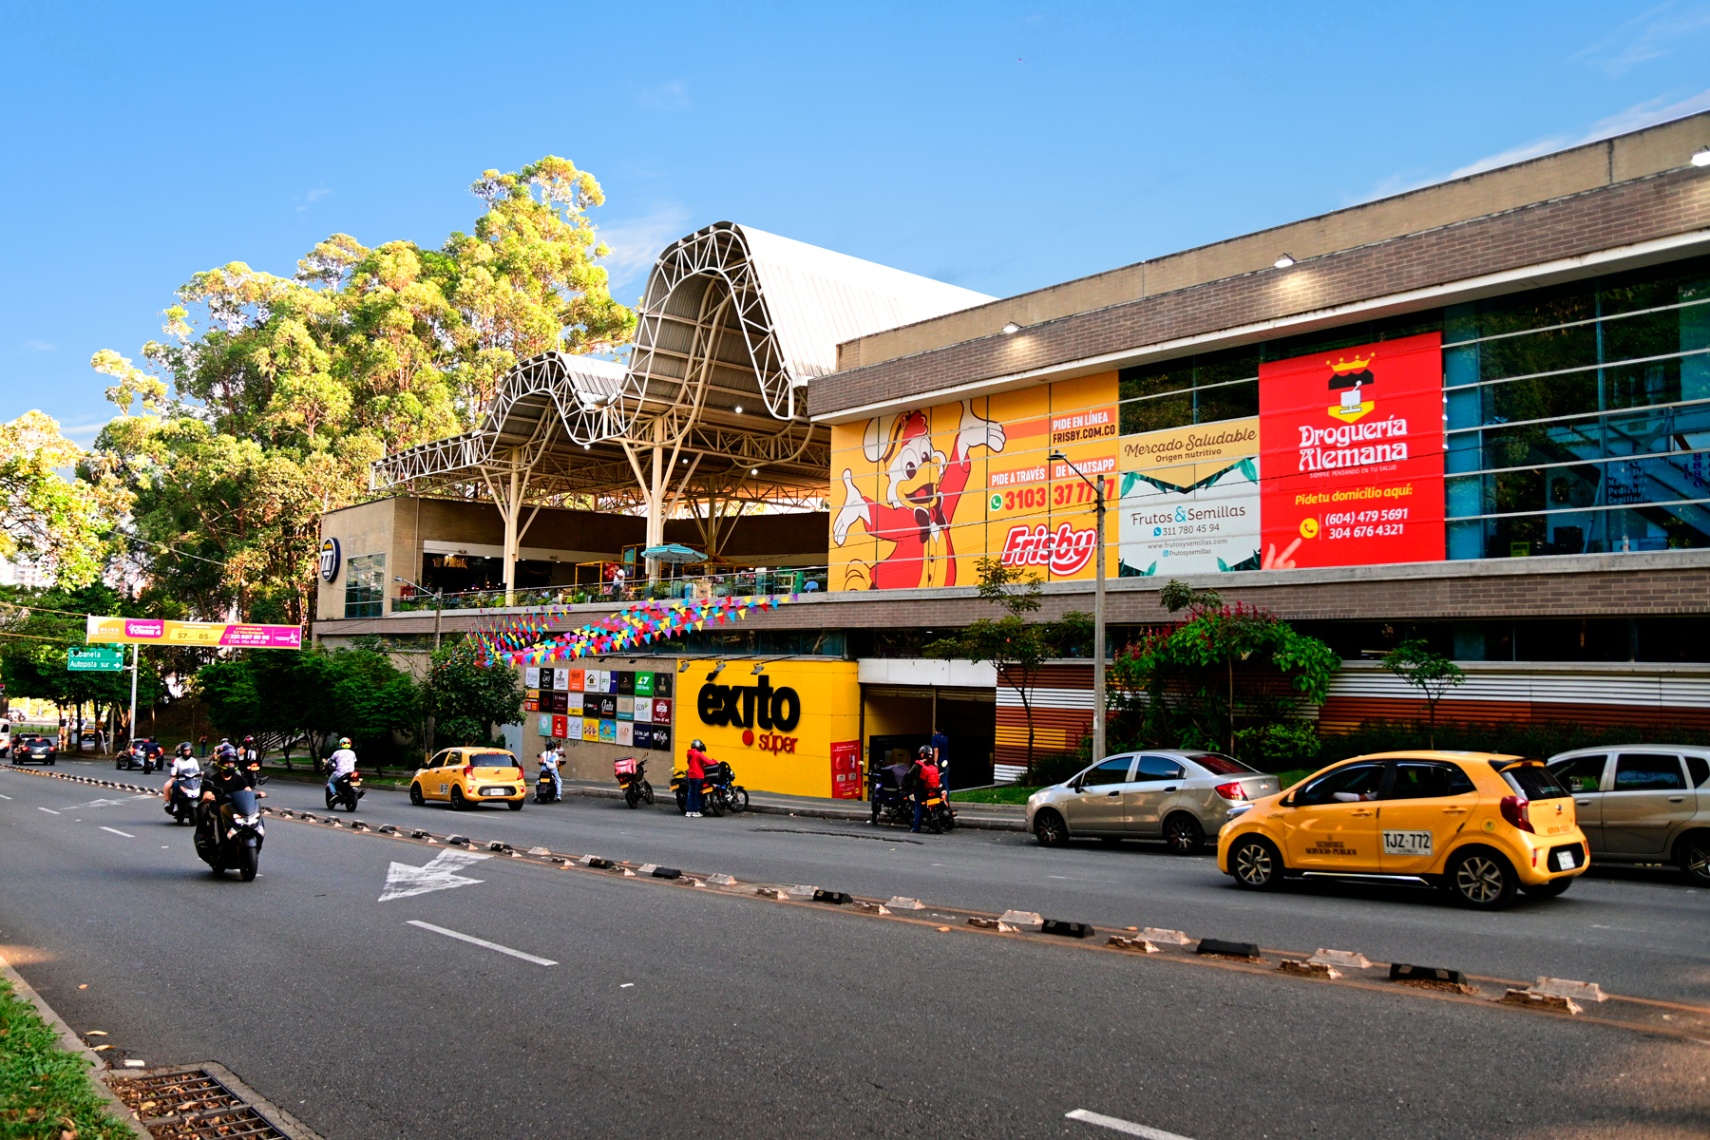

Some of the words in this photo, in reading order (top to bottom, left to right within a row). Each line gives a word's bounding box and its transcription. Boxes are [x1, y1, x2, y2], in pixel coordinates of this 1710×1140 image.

[1052, 418, 1071, 432] PIDE
[1072, 416, 1083, 428] EN
[1084, 410, 1109, 426] LÍNEA
[1298, 414, 1408, 448] Droguería
[1052, 424, 1116, 444] FRISBY.COM.CO
[1125, 437, 1184, 458] Mercado
[1185, 428, 1257, 451] Saludable
[1155, 453, 1183, 463] Origen
[1185, 448, 1222, 459] nutritivo
[1298, 441, 1408, 472] Alemana
[991, 472, 1009, 486] PIDE
[1009, 471, 1016, 484] A
[1016, 465, 1046, 482] TRAVÉS
[1055, 465, 1067, 478] DE
[1331, 468, 1360, 478] PENSANDO
[1379, 464, 1397, 472] SALUD
[1004, 487, 1046, 511] 3103
[1053, 483, 1073, 506] 37
[1332, 486, 1383, 503] domicilio
[1384, 483, 1414, 500] aquí:
[1131, 511, 1173, 526] Frutos
[1175, 505, 1187, 523] &
[1187, 505, 1246, 521] Semillas
[1325, 511, 1355, 528] (604)
[1356, 510, 1379, 523] 479
[1380, 507, 1409, 522] 5691
[1162, 527, 1177, 536] 311
[1178, 525, 1194, 535] 780
[1196, 524, 1207, 533] 45
[1209, 523, 1220, 532] 94
[1329, 527, 1351, 540] 304
[1353, 525, 1373, 538] 676
[1375, 523, 1404, 537] 4321
[1000, 521, 1098, 577] Frisby
[1147, 538, 1228, 550] www.frutosysemillas.com
[70, 661, 97, 669] Autopista
[697, 672, 801, 733] éxito
[758, 731, 798, 756] súper
